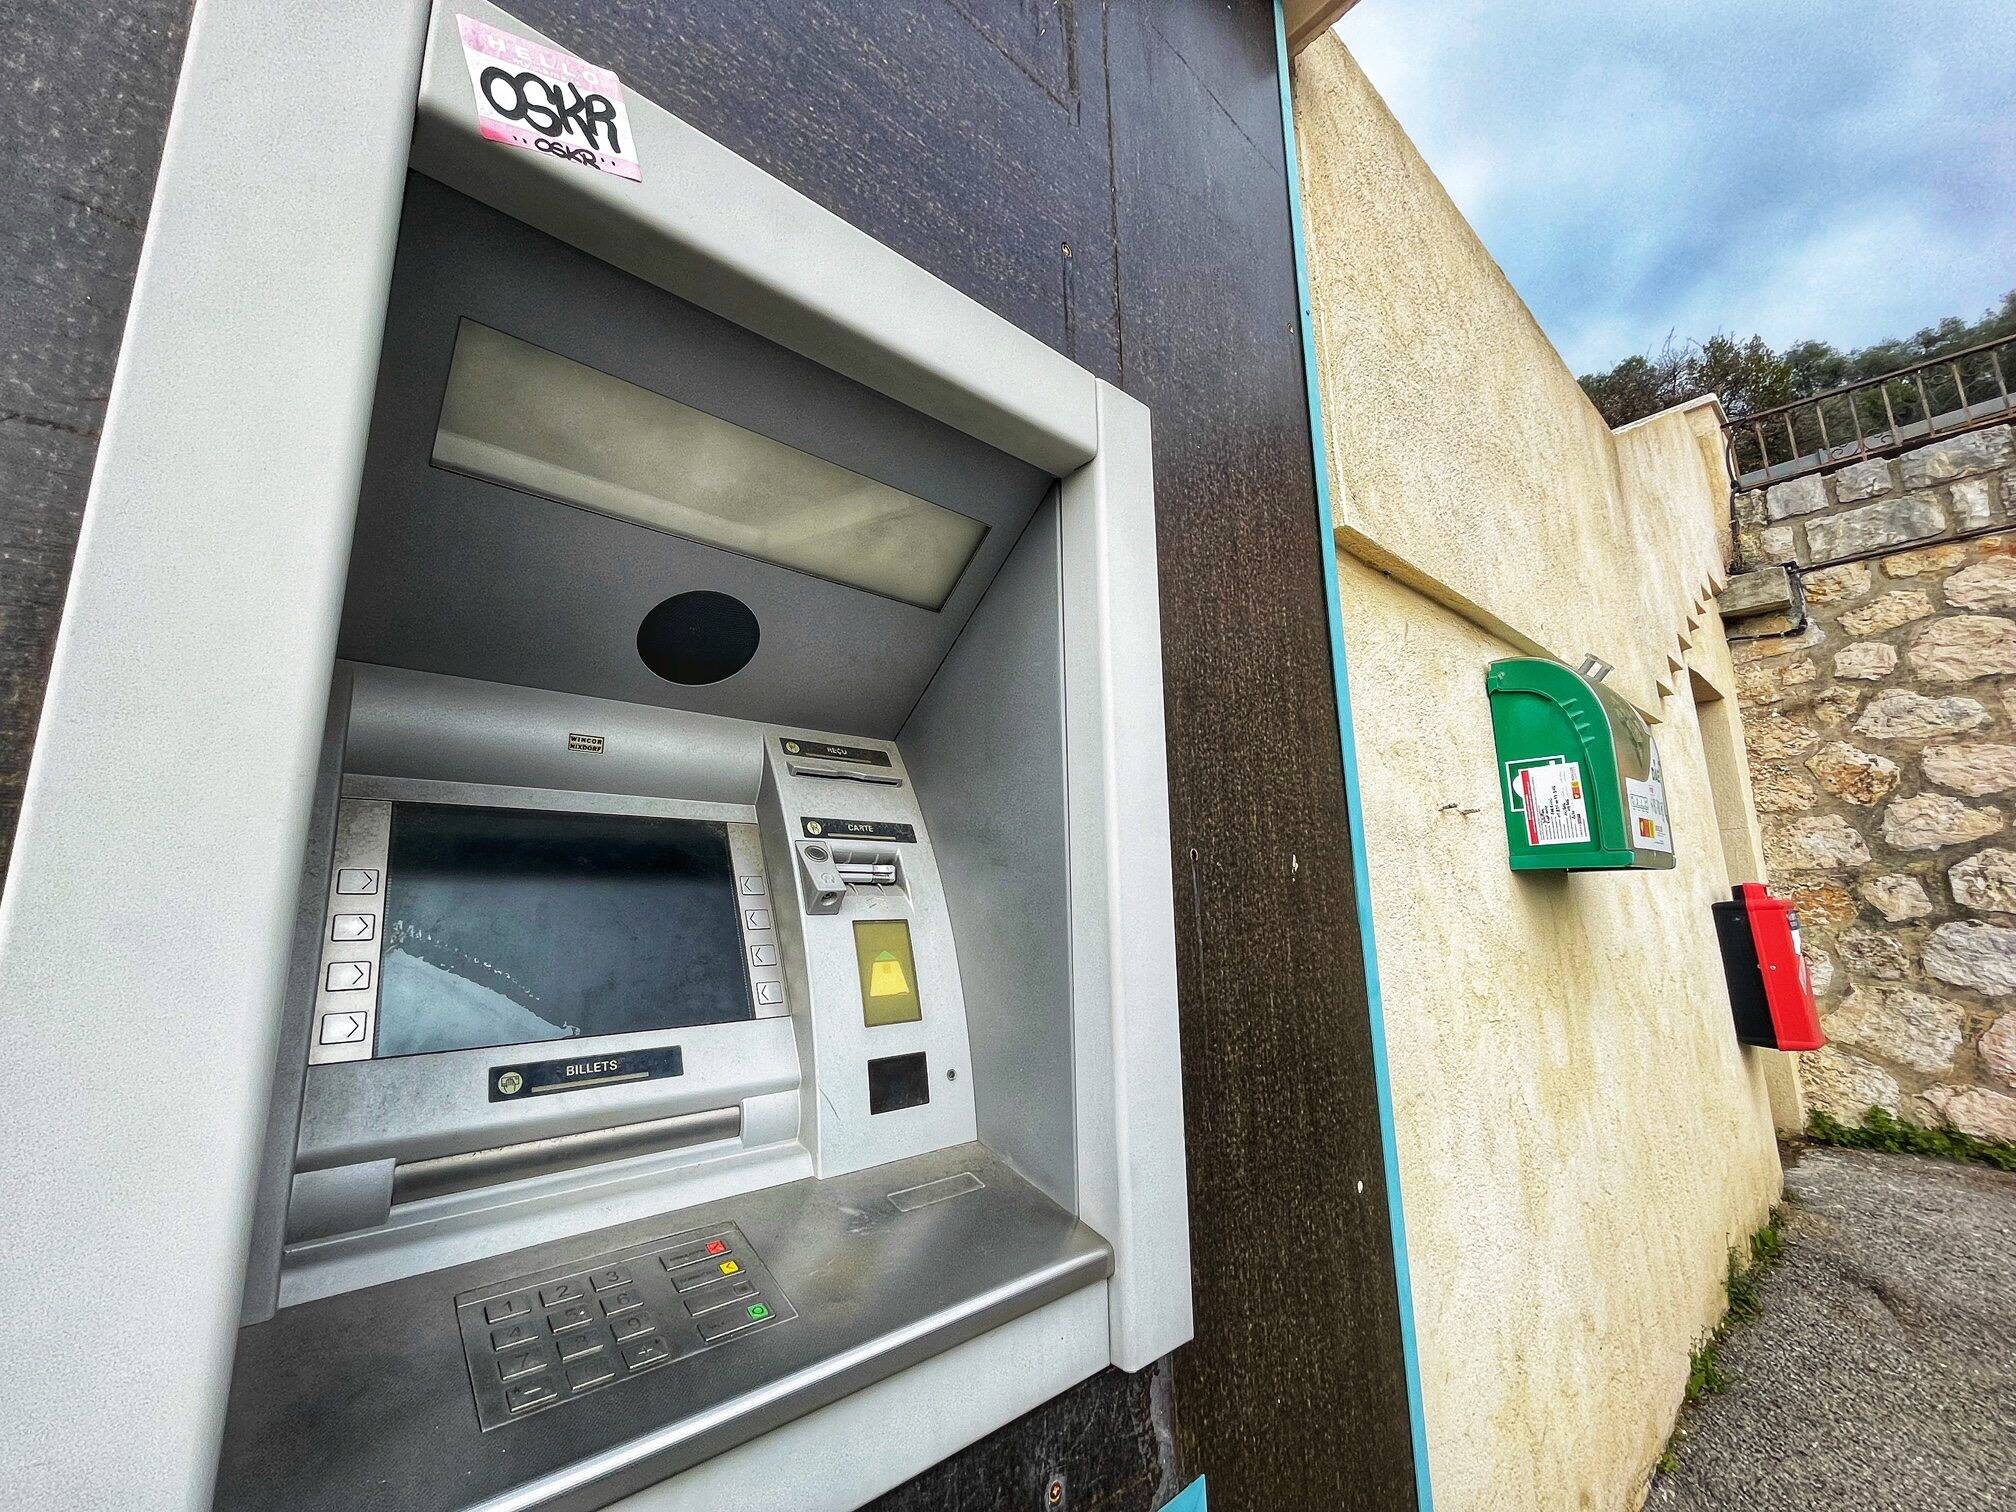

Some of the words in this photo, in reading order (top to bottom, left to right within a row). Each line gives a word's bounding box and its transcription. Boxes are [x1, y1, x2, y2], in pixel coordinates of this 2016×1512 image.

[480, 66, 621, 153] OSKR
[571, 736, 602, 745] WINCOR
[570, 743, 602, 752] NIXDORF
[826, 747, 848, 756] REÇU
[847, 823, 874, 833] CARTE
[566, 1059, 618, 1077] BILLETS
[503, 1300, 514, 1312] 1
[556, 1285, 570, 1298] 2
[606, 1271, 620, 1283] 3
[616, 1294, 629, 1305] 6
[515, 1352, 530, 1367] 7
[627, 1317, 641, 1331] 9
